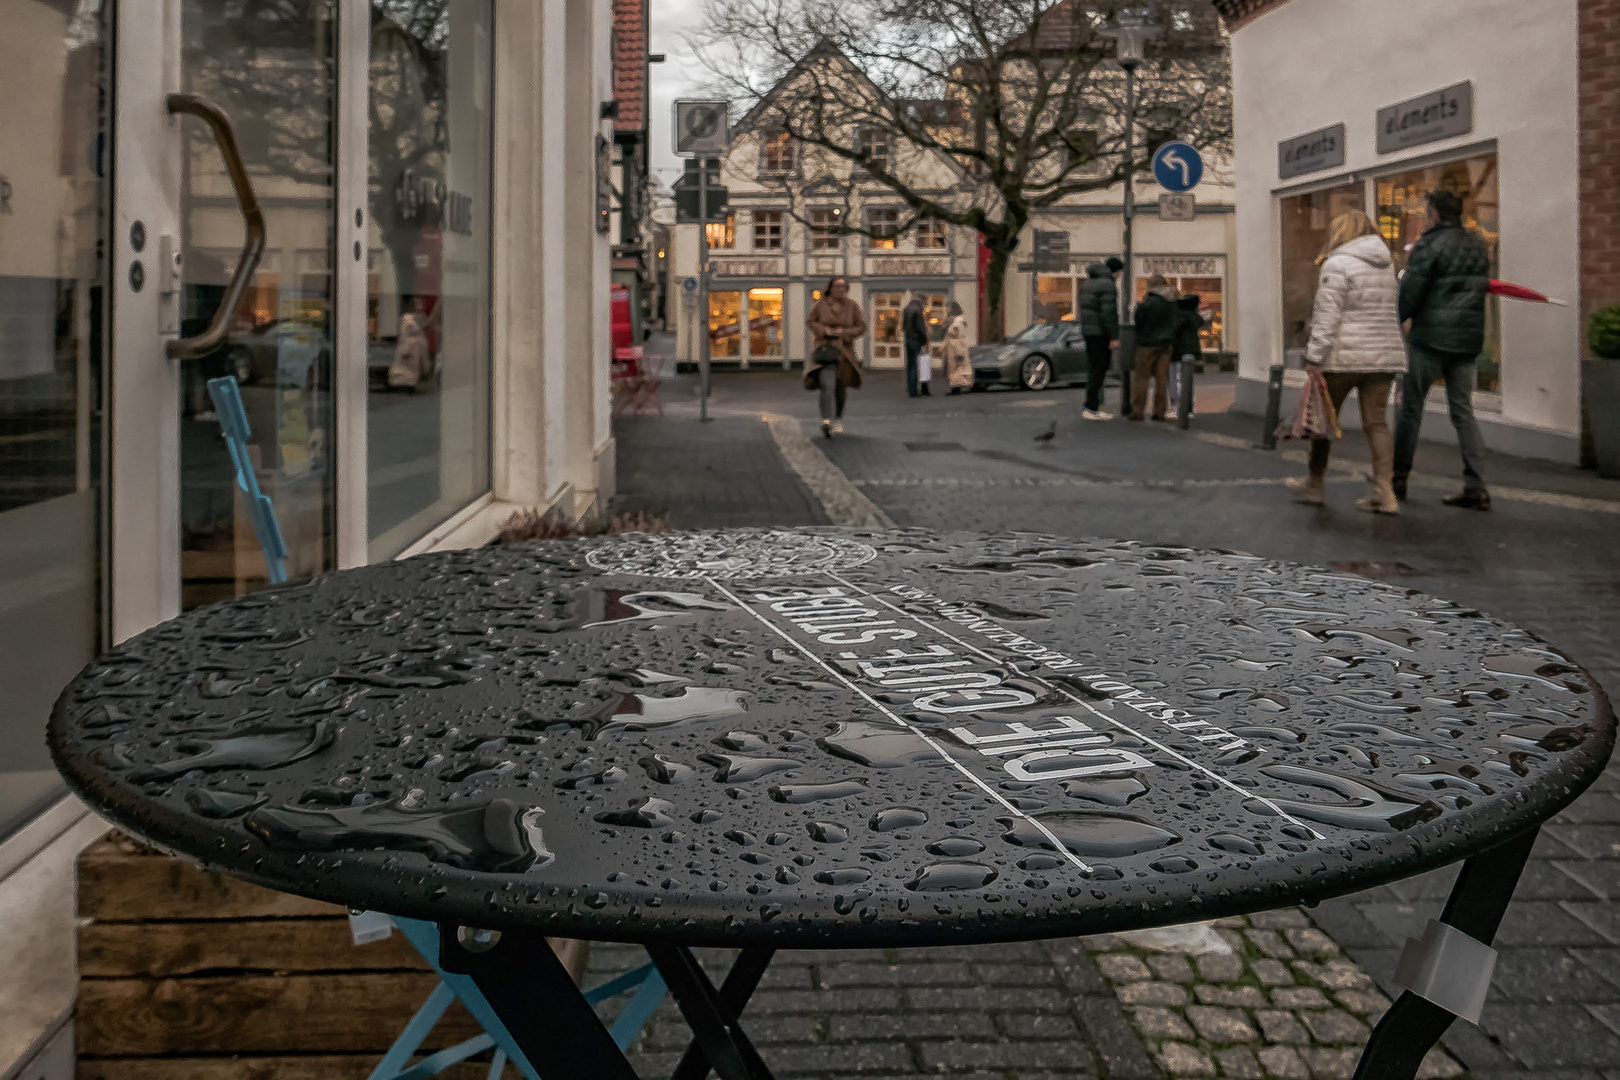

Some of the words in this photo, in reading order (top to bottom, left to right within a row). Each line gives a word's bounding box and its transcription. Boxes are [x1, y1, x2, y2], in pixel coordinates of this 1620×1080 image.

[755, 587, 918, 645] STUBE
[853, 644, 1036, 714] GUTE
[948, 715, 1155, 781] DIE
